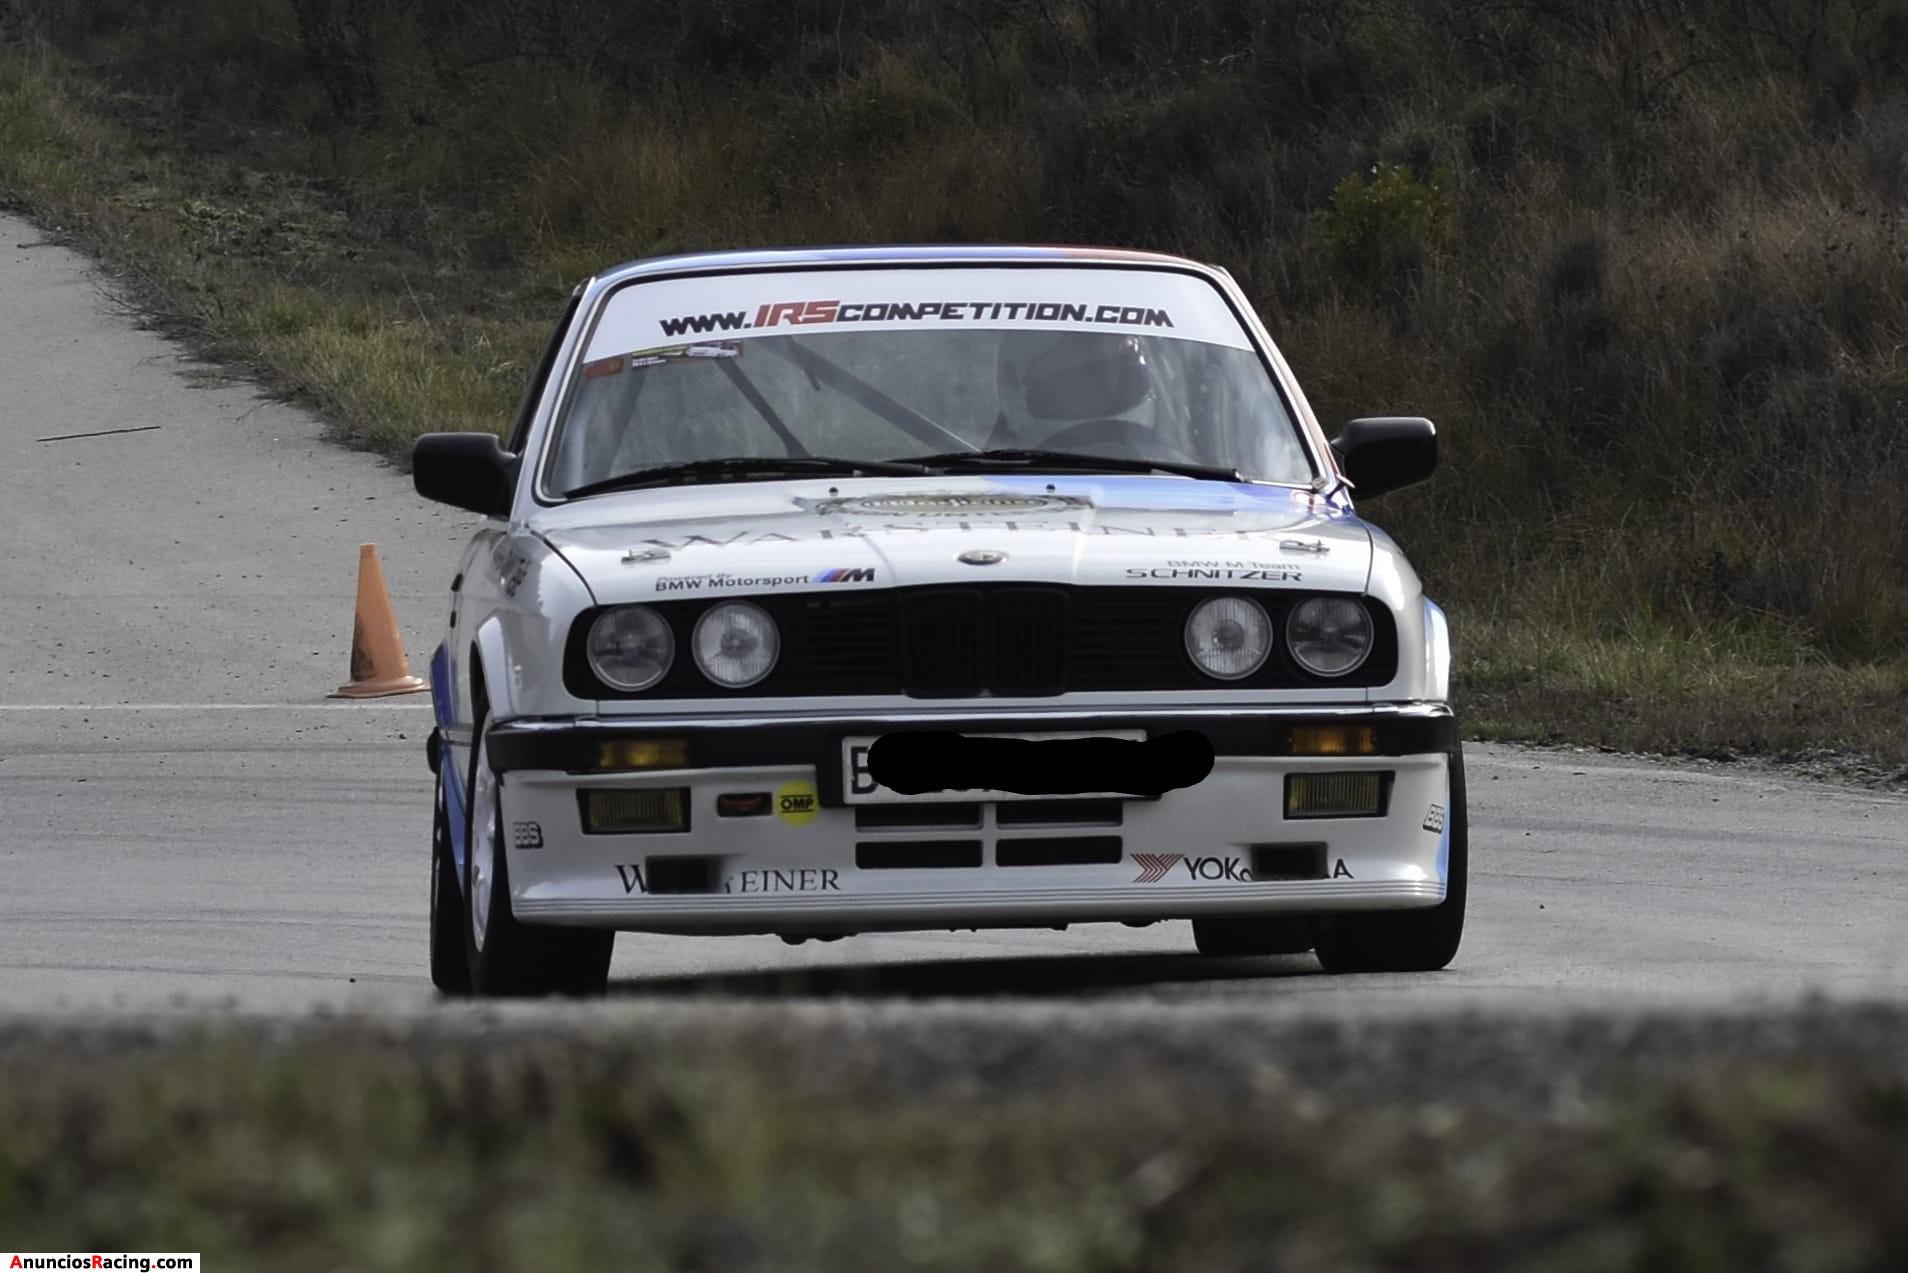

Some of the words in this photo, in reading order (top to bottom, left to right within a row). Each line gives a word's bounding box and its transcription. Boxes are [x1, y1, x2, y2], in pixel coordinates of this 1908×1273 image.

[1126, 568, 1302, 582] SCHNITZER
[655, 578, 702, 592] BMW
[708, 575, 809, 588] Motorsport
[780, 797, 814, 810] OMP
